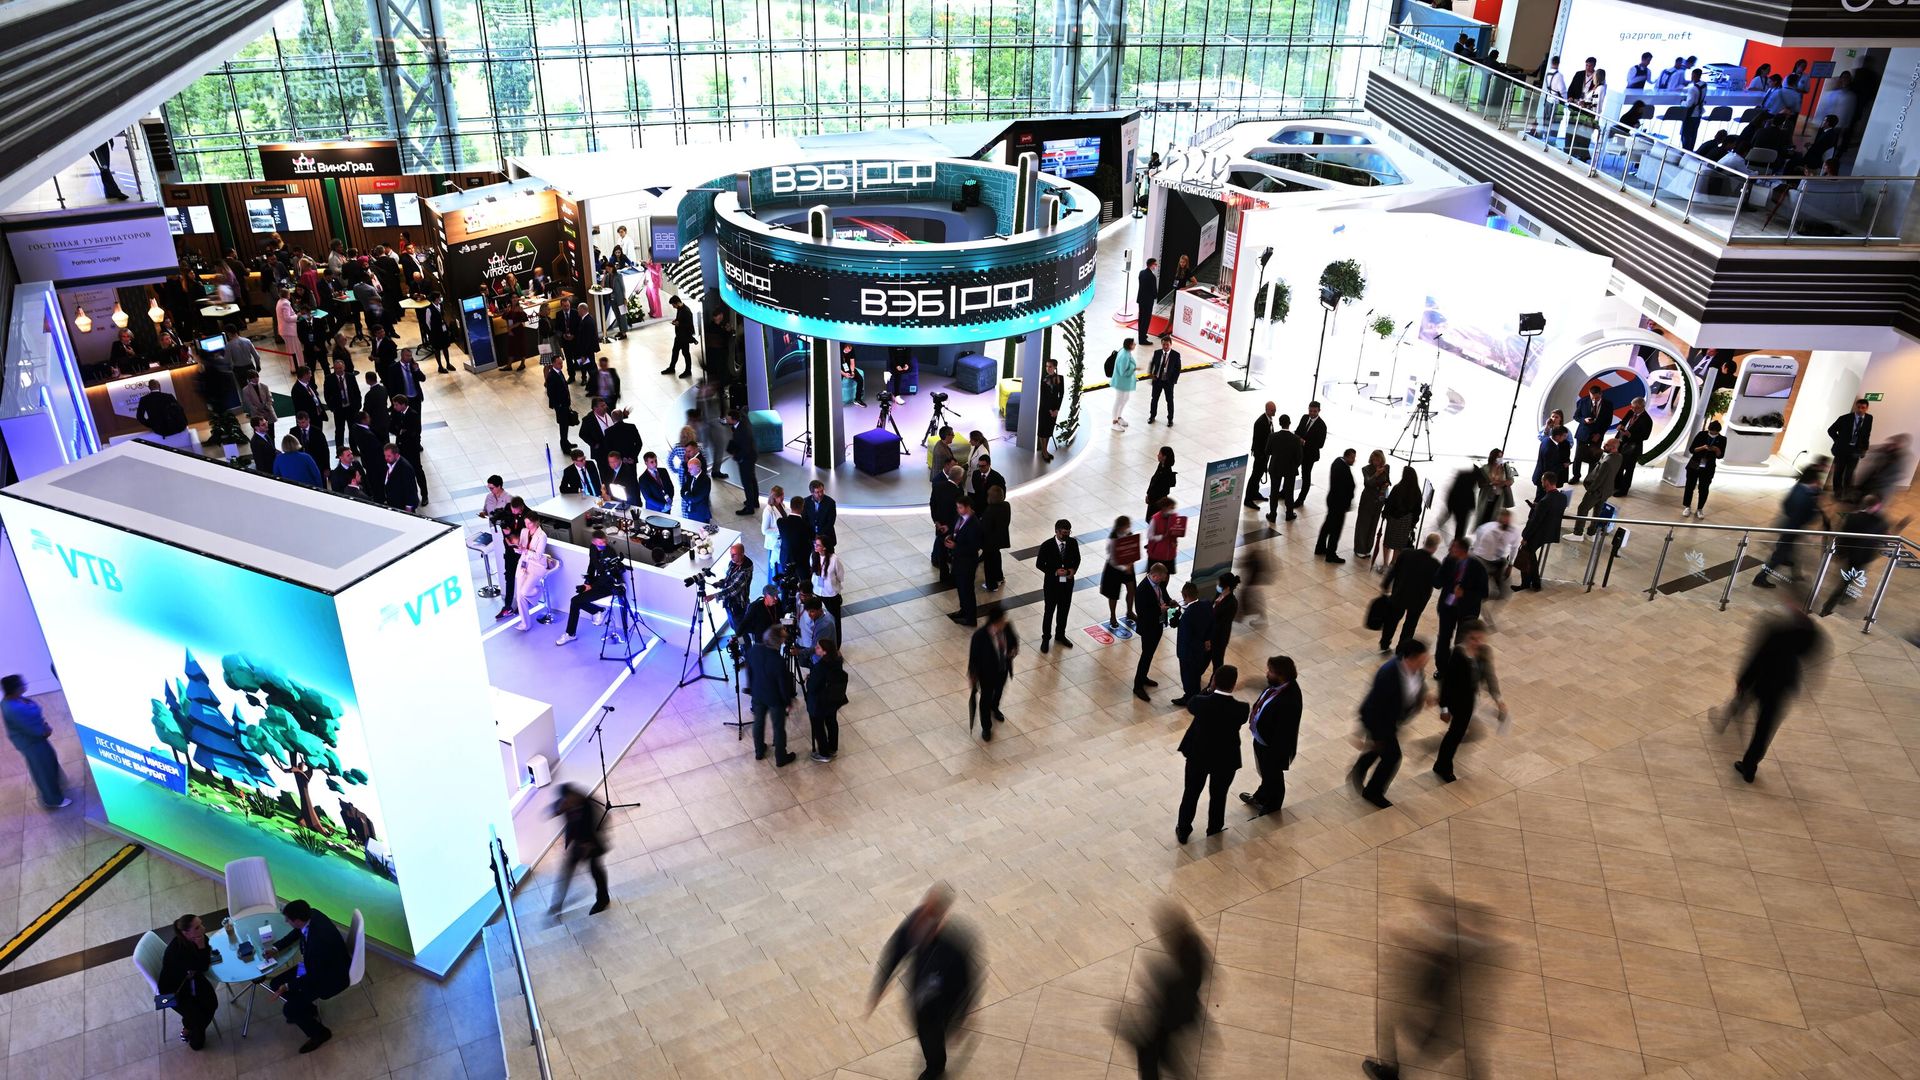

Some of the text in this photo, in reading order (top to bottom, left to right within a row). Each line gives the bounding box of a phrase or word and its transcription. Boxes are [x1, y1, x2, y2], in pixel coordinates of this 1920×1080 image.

[1620, 32, 1693, 41] gazprom_neft
[1884, 61, 1920, 162] газпром_нефт
[316, 161, 374, 174] ВиноГрад
[1153, 178, 1180, 192] ГРУППА
[83, 232, 151, 245] ГУБЕРНАТОРОВ
[483, 261, 522, 279] VinoGrad
[56, 544, 124, 593] VTB
[403, 575, 463, 626] VTB
[95, 736, 110, 749] ЛЕС
[146, 756, 180, 776] ИМЕНЕМ
[99, 748, 167, 782] НИКТО НЕ ВЫРУБИТ
